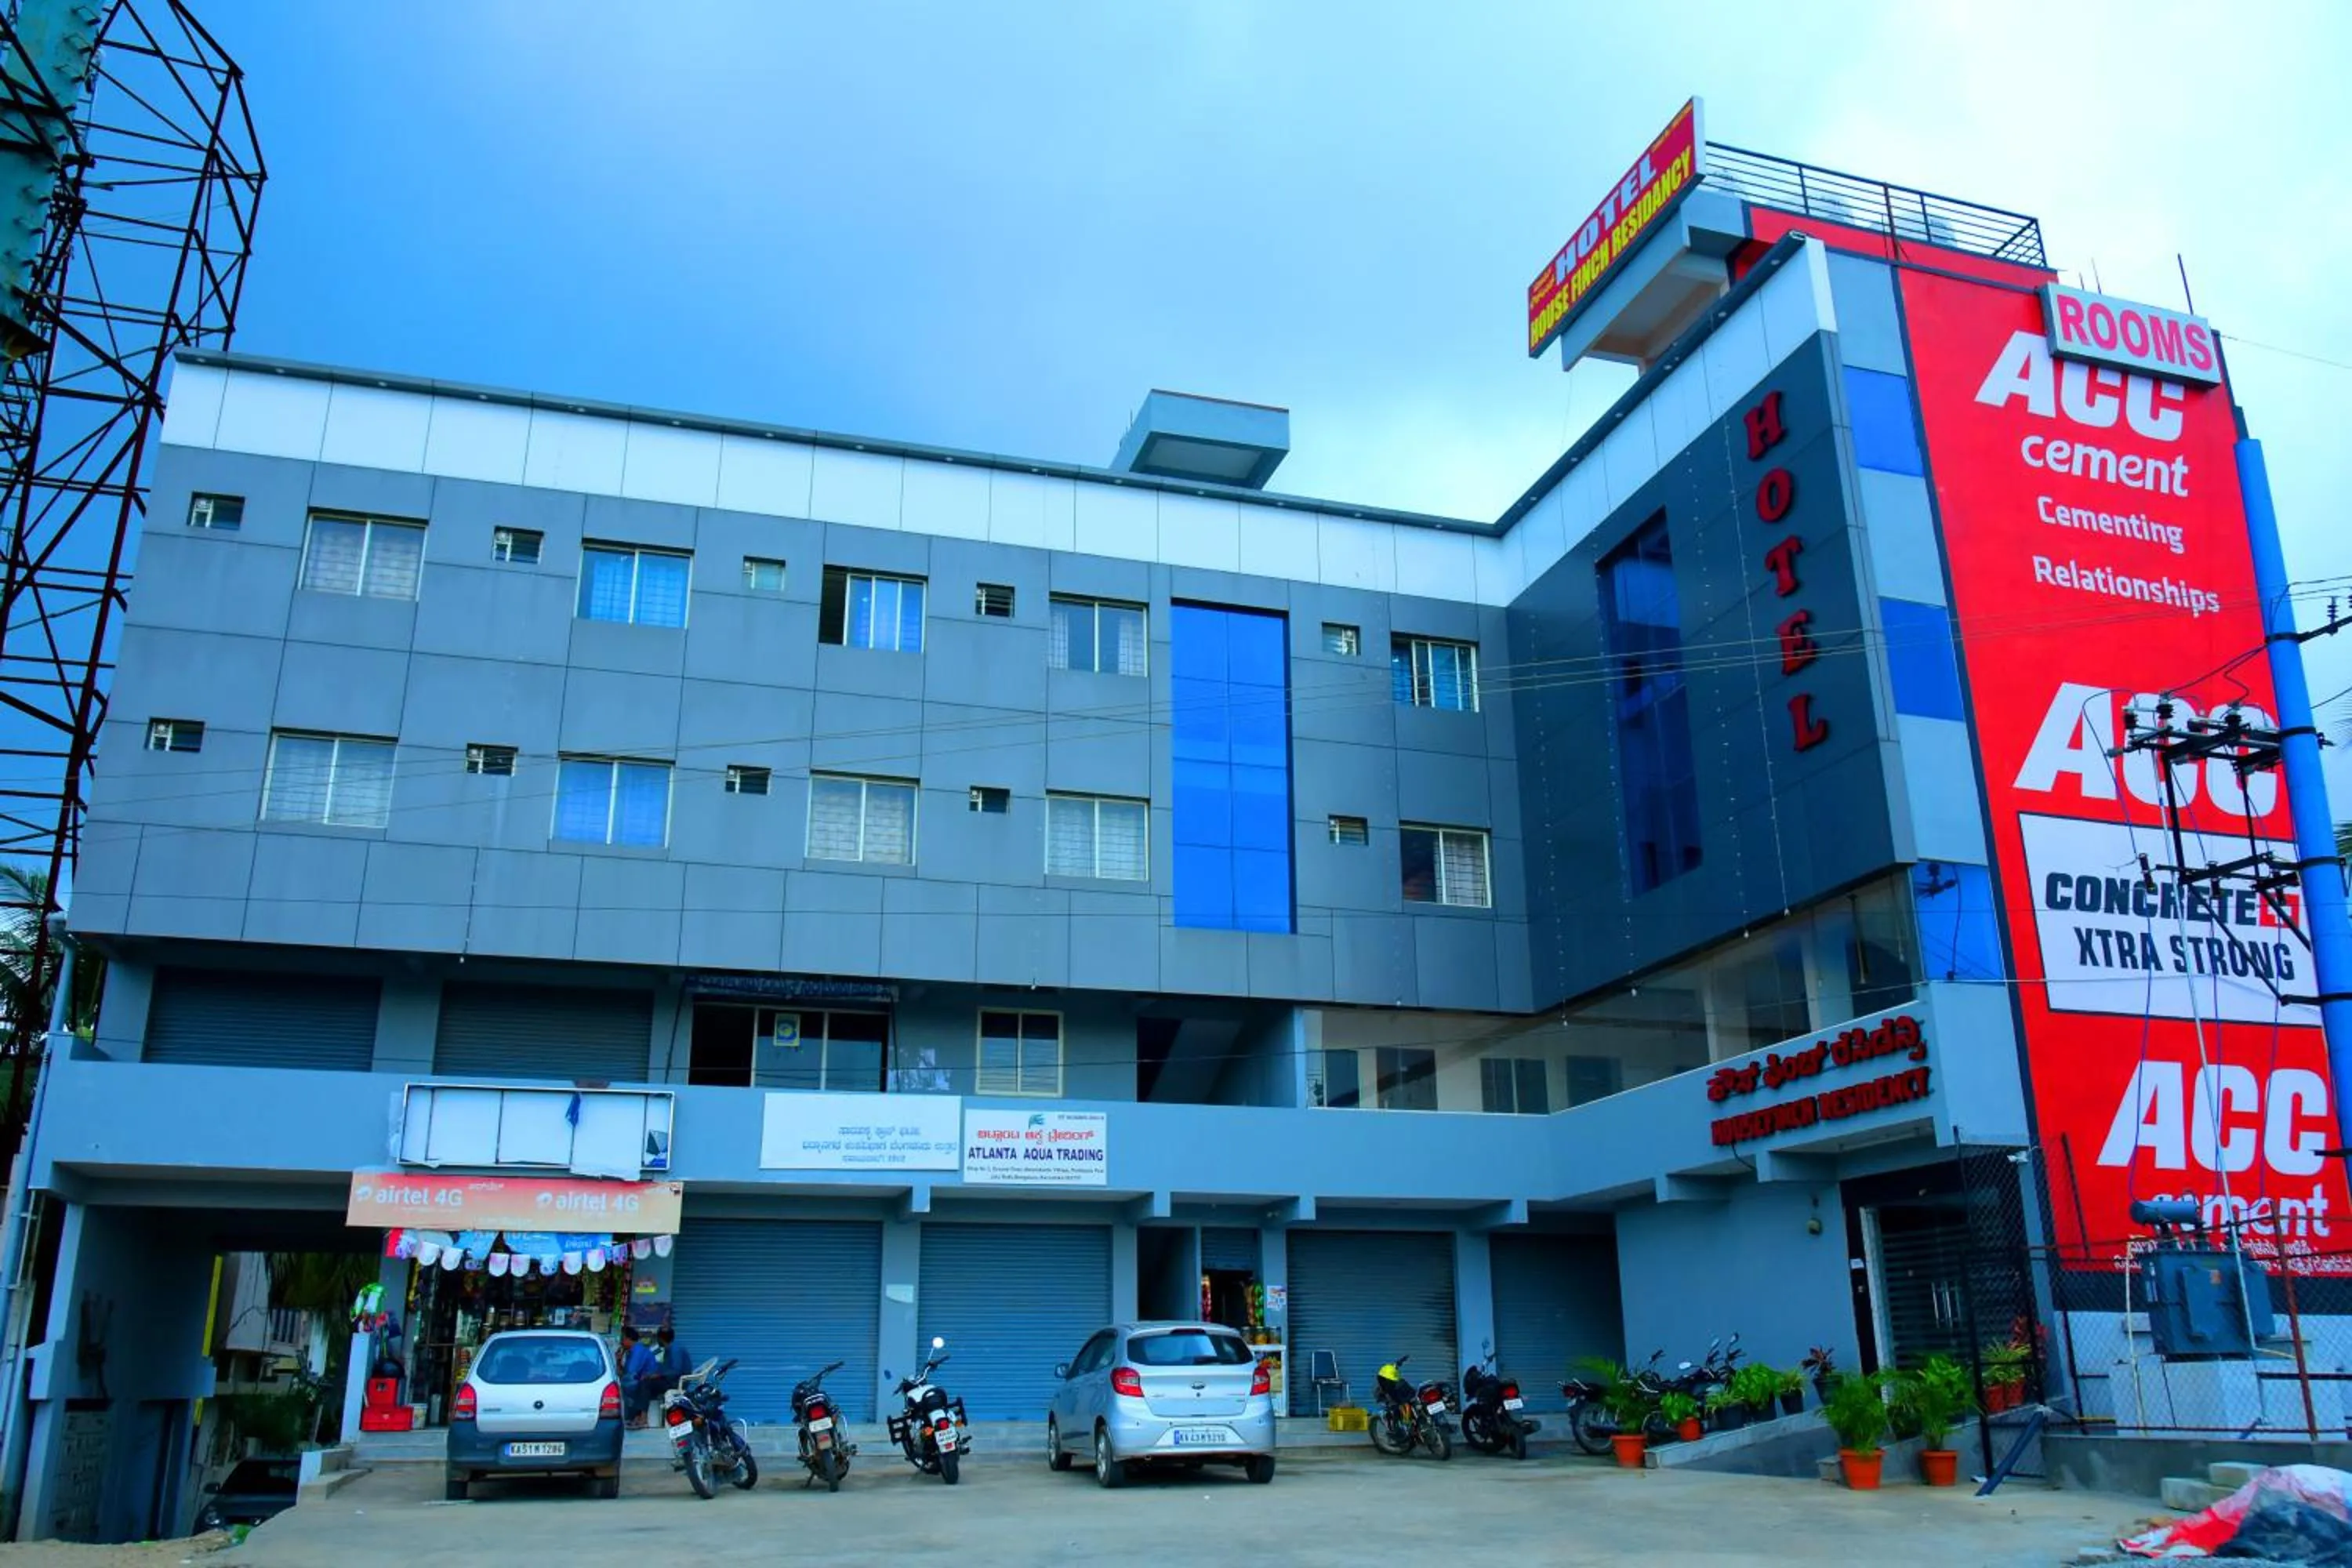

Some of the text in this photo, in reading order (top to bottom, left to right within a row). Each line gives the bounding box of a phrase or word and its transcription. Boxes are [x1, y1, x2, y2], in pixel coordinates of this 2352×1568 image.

[1530, 283, 1570, 348] HOUSE
[1570, 238, 1609, 303] FINCH
[1611, 145, 1692, 259] RESIDANCY
[1554, 154, 1657, 286] HOTEL
[2056, 293, 2212, 371] ROOMS
[1973, 330, 2185, 442] ACC
[2020, 435, 2189, 497] cement
[2038, 495, 2184, 554] Cementing
[1743, 390, 1828, 753] HOTEL
[2032, 555, 2220, 618] Relationships
[2012, 681, 2278, 817] ACC
[2074, 927, 2163, 972] XTRA
[2171, 932, 2296, 981] STRONG
[2096, 1060, 2328, 1177] ACC
[968, 1147, 1104, 1161] ATLANTA AQUA TRADING
[376, 1185, 463, 1206] airtel 4G
[556, 1191, 640, 1211] airtel 4G
